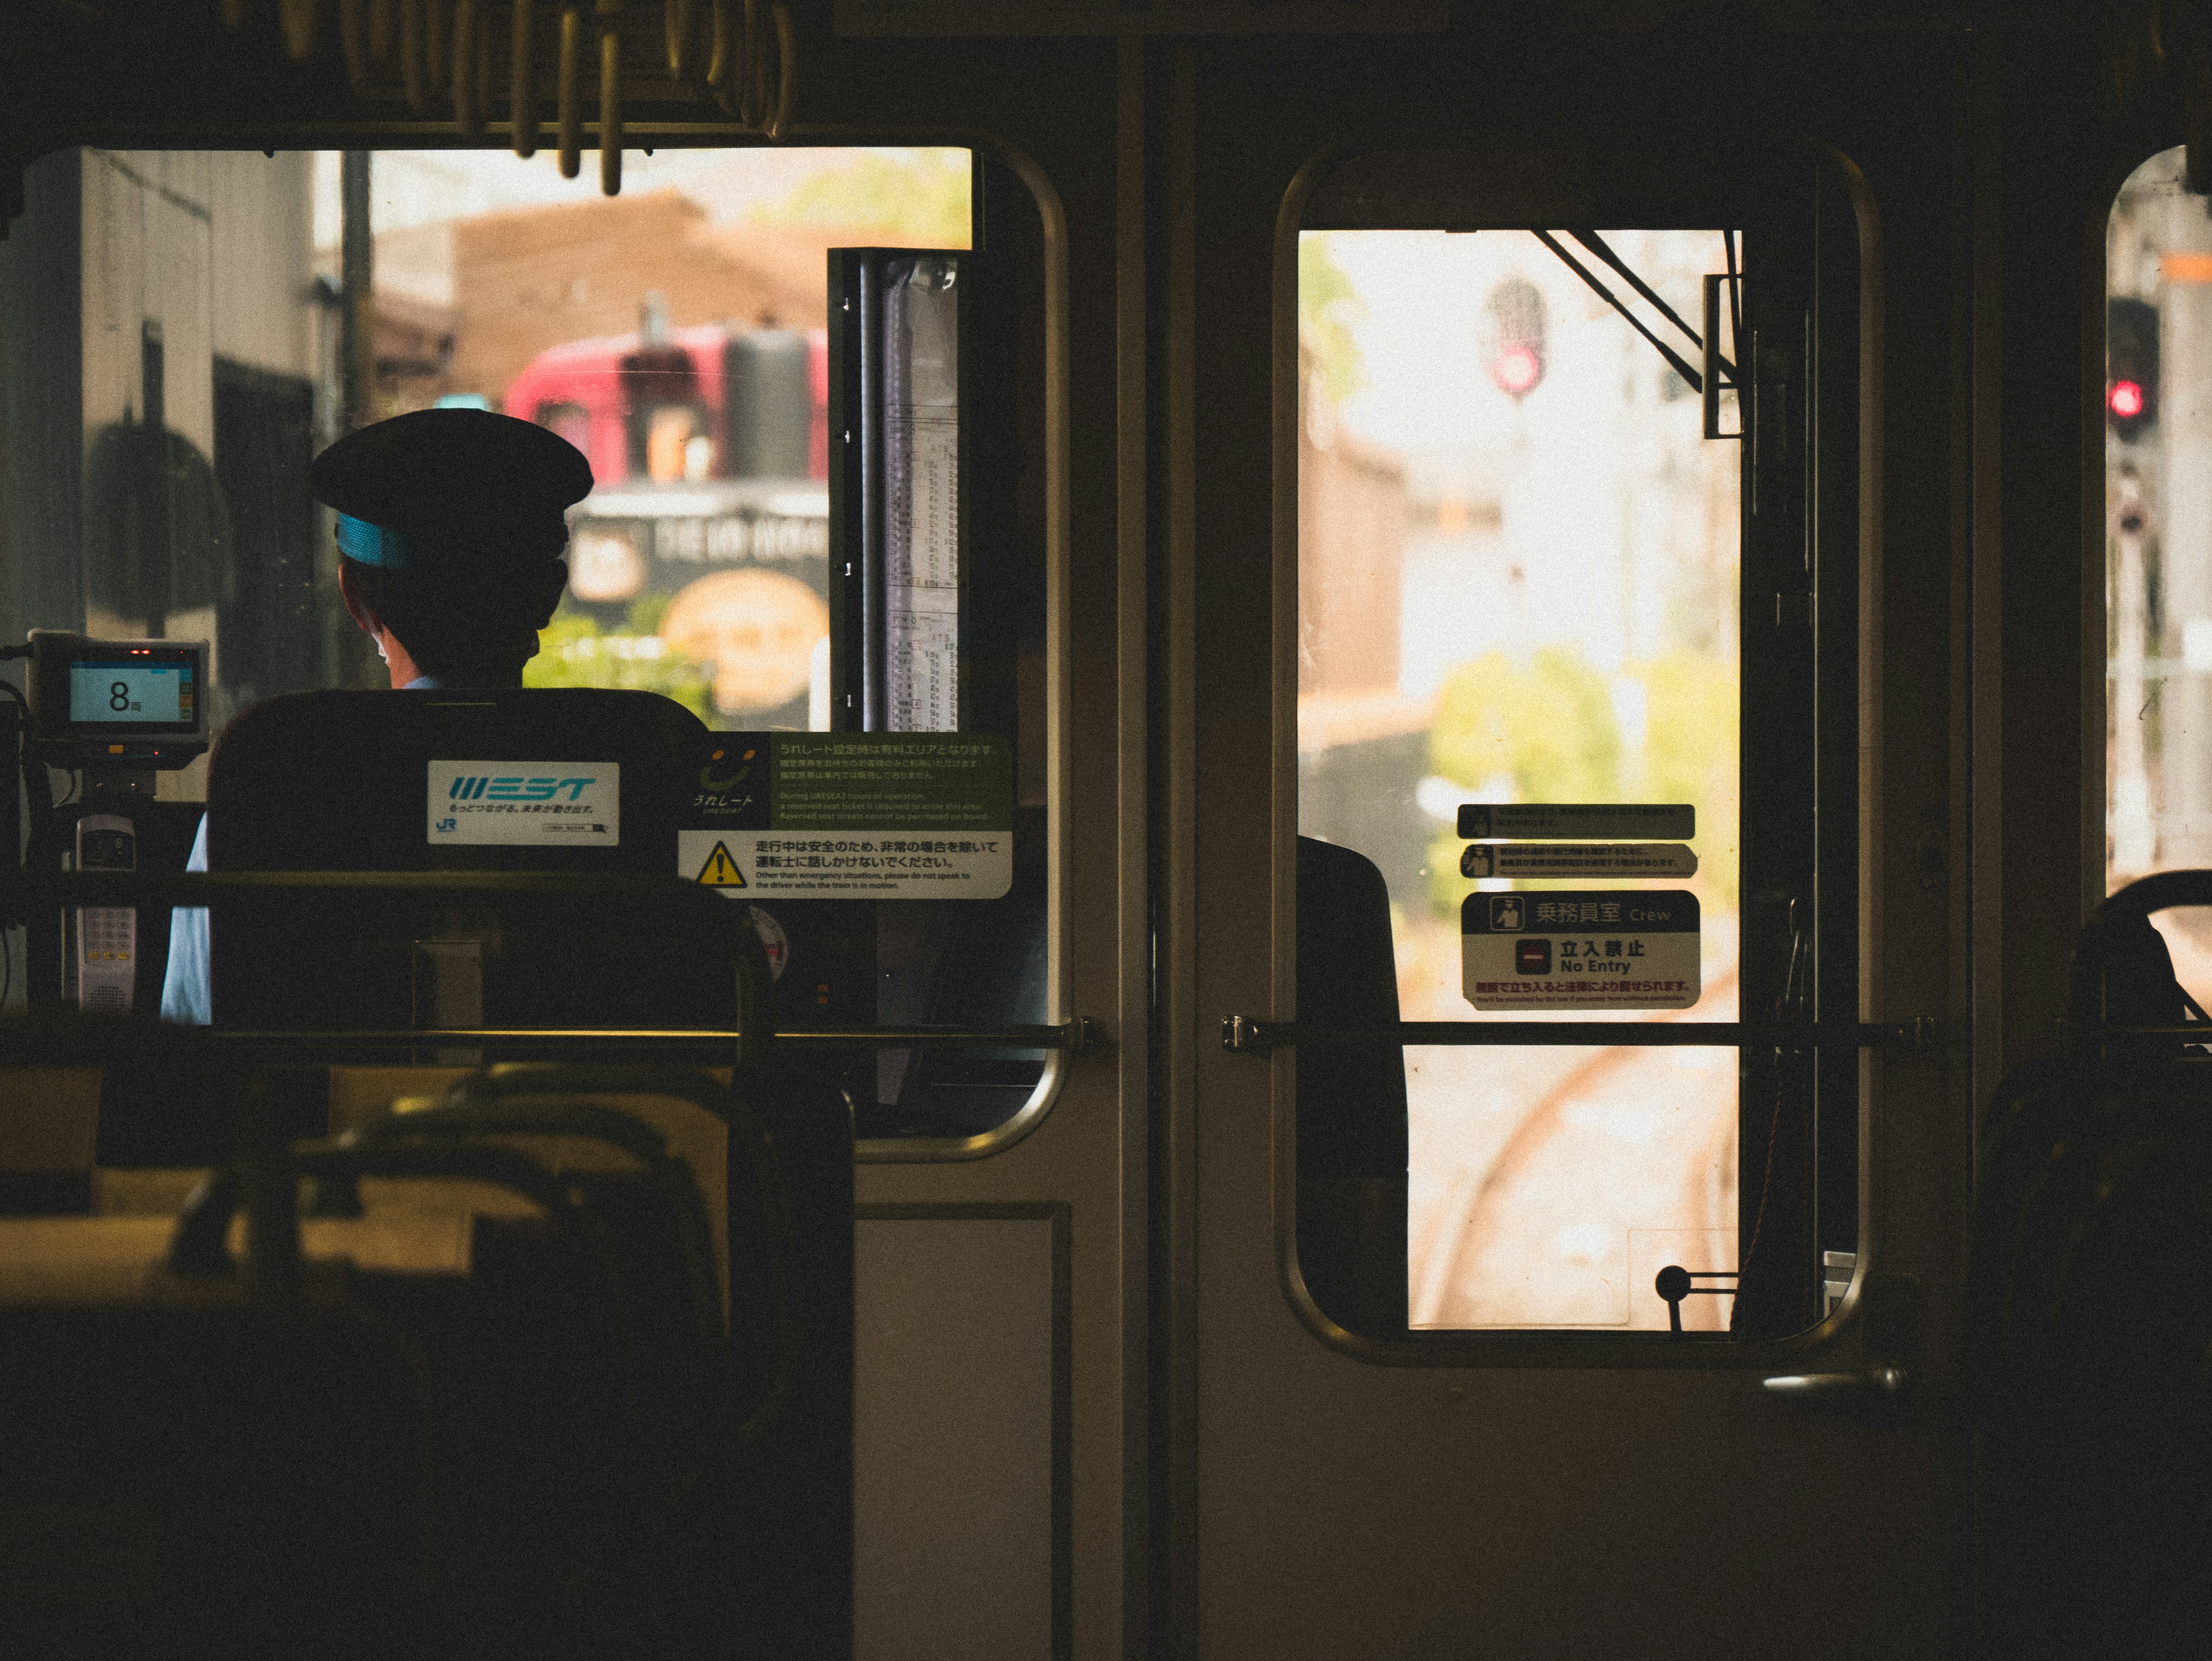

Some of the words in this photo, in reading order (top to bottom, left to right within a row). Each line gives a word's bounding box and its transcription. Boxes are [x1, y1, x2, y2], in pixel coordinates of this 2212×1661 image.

[932, 634, 949, 642] ATS
[449, 777, 596, 801] WEST
[693, 795, 752, 806] うれしート
[780, 792, 808, 801] During
[435, 818, 457, 830] JR
[755, 841, 998, 853] 走行中は安全のため、非常の場合を除いて
[755, 856, 954, 868] 運転士に話しかけないでください。
[884, 872, 909, 881] please
[937, 872, 960, 881] speak
[1537, 903, 1621, 923] 乗務員室
[1630, 908, 1671, 922] Crew
[1561, 940, 1646, 958] 立入禁止
[1561, 960, 1583, 973] No
[1589, 960, 1631, 975] Entry
